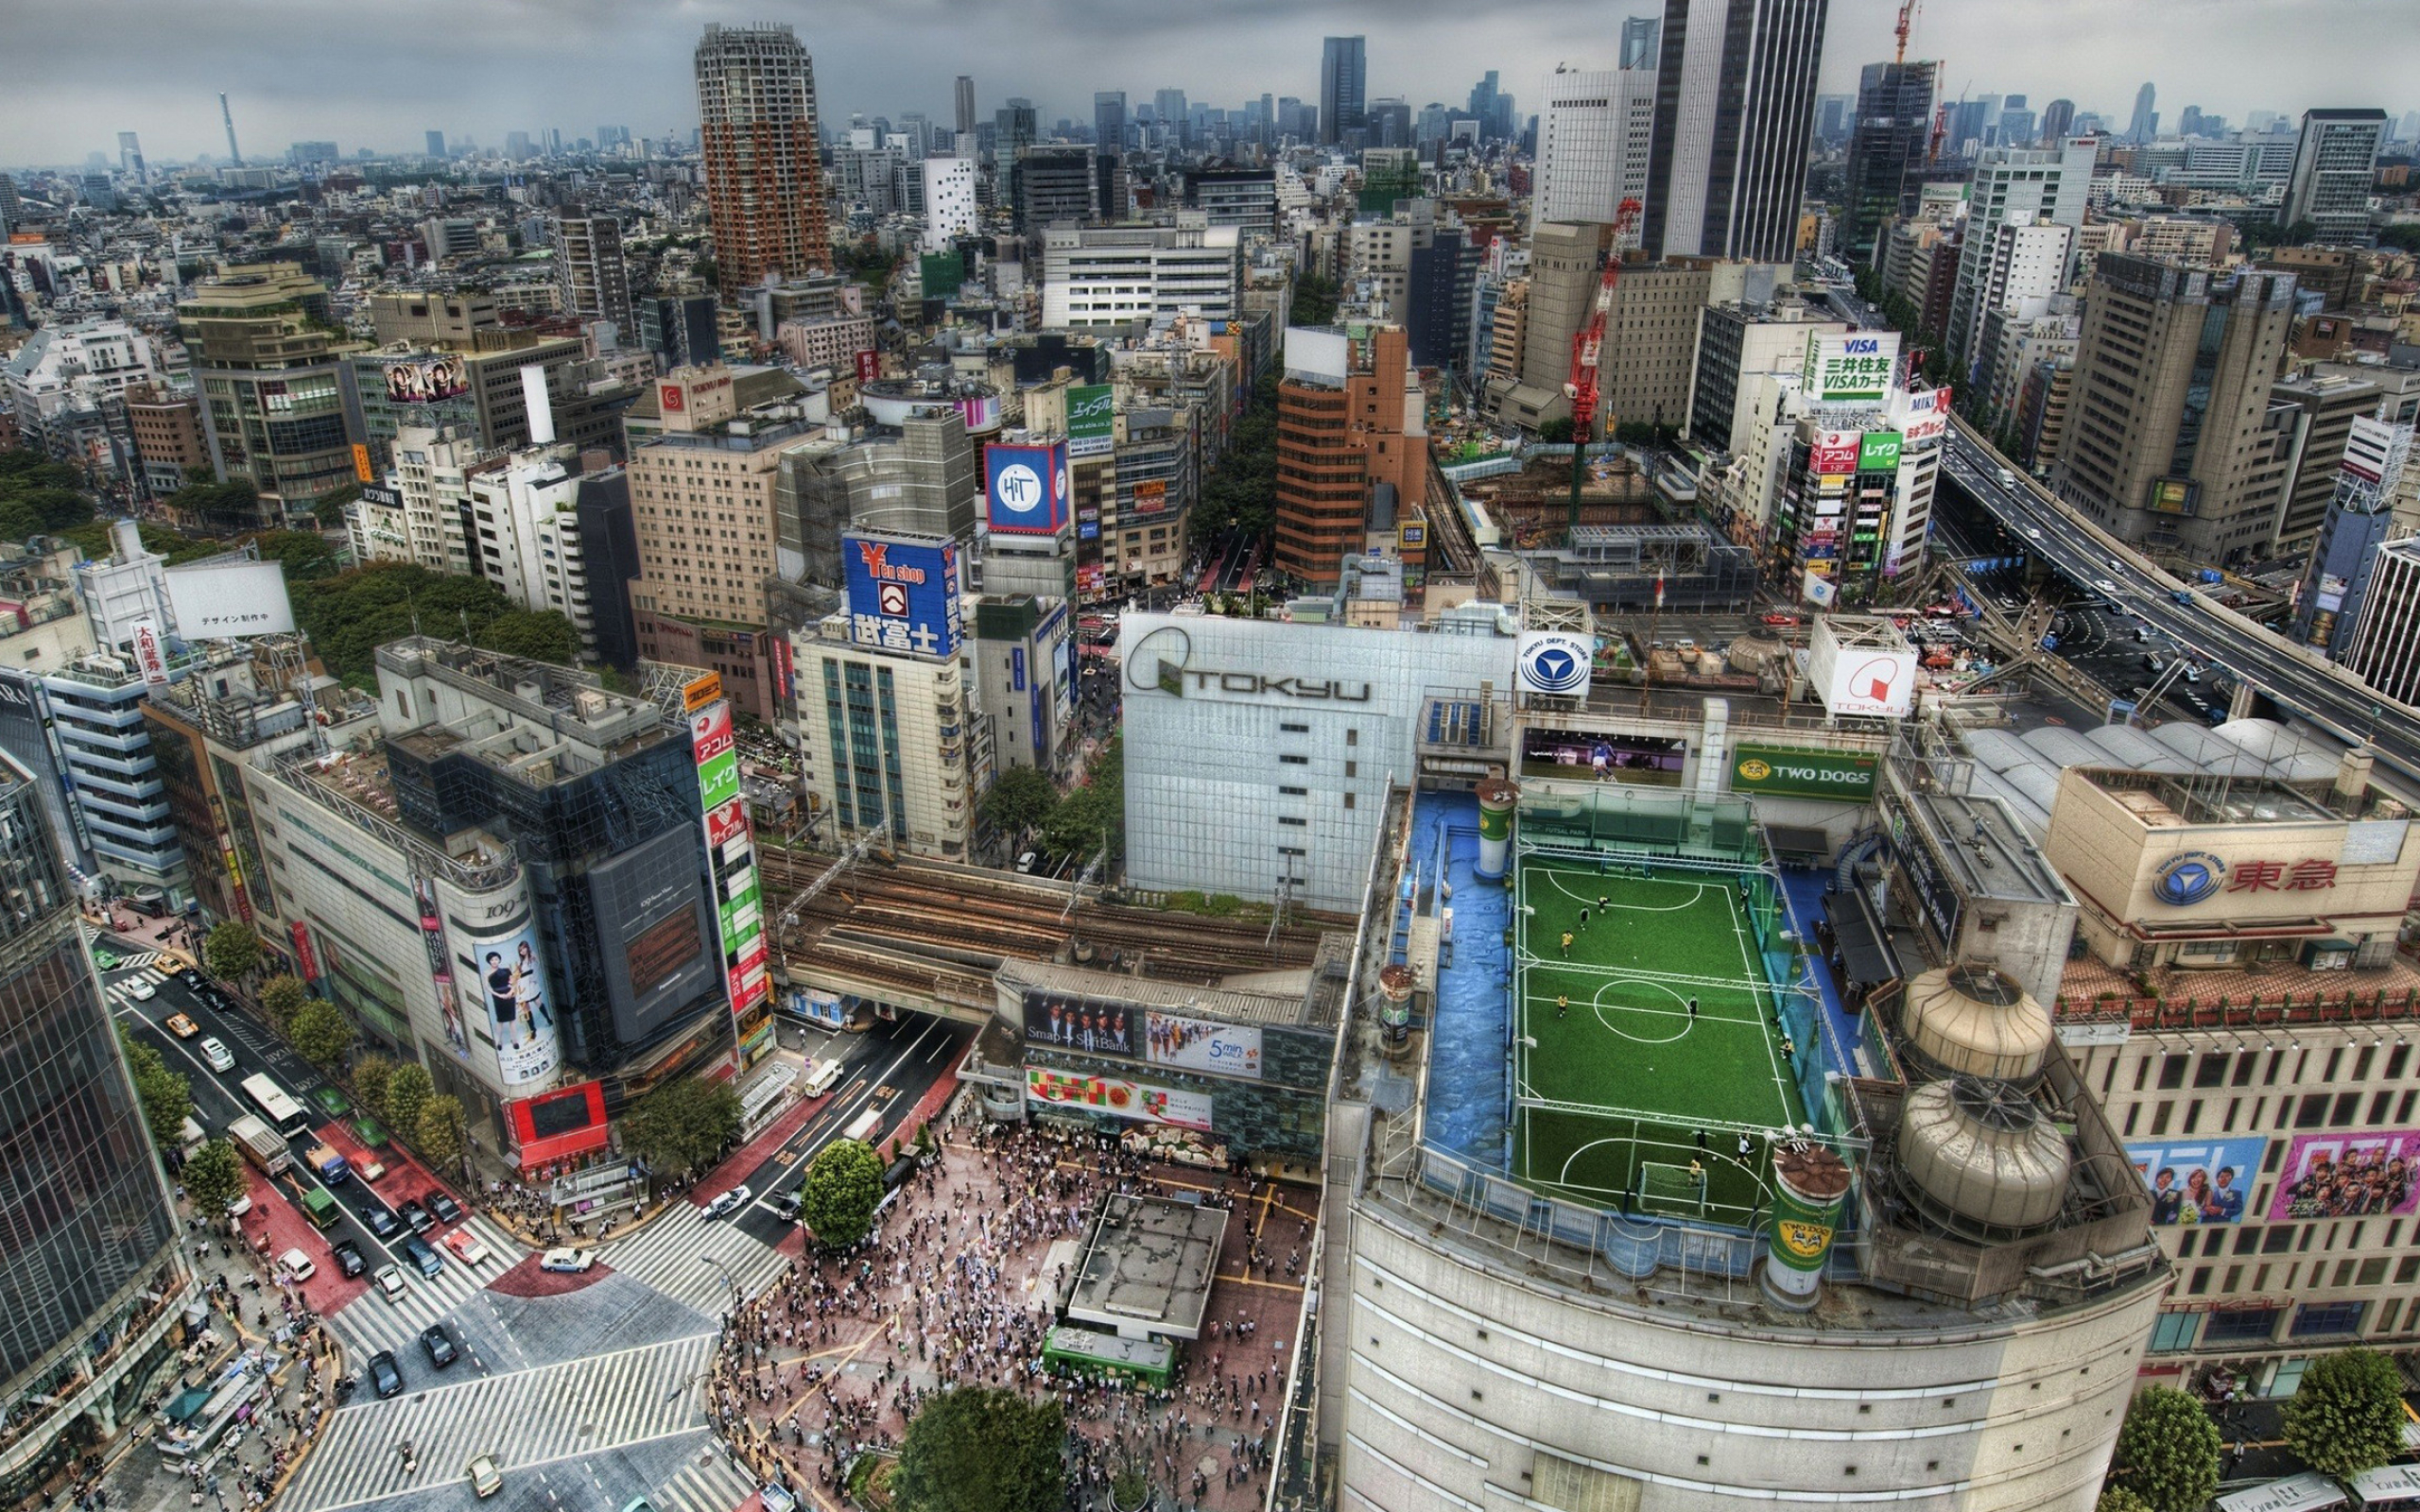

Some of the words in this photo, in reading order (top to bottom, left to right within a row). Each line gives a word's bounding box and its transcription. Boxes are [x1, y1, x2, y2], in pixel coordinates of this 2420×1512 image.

[1844, 339, 1877, 353] VISA
[1824, 357, 1891, 373] 三井住友
[692, 378, 716, 395] TOKYU
[1824, 375, 1889, 389] VISAカード
[1069, 394, 1113, 418] エイブル
[1910, 395, 1936, 411] MIKI
[1907, 421, 1945, 438] ミキプルーン
[1824, 450, 1854, 461] アコム
[1865, 443, 1897, 455] レイク
[897, 564, 925, 584] shop
[201, 613, 269, 626] デザイン制作中
[854, 613, 939, 654] 武富士
[136, 627, 162, 673] 大和証券
[1521, 640, 1544, 659] TOKYU
[1546, 637, 1566, 645] DEPT.
[1569, 642, 1589, 662] STORE
[689, 680, 720, 704] プロミス
[1184, 669, 1370, 702] TOKYU
[1833, 702, 1905, 714] TOKYU
[700, 734, 733, 759] アコム
[703, 765, 735, 795] レイク
[1772, 765, 1816, 782] TWO
[1819, 768, 1871, 784] DOGS
[712, 820, 744, 845] アイフル
[1545, 827, 1568, 835] FUTSAL
[1569, 828, 1587, 836] PARK
[2155, 853, 2183, 875] TOKYU
[1910, 860, 1930, 907] FUTSAL
[2226, 858, 2340, 893] 東急
[1028, 1025, 1061, 1044] Smap
[1209, 1040, 1223, 1057] 5
[1783, 1222, 1806, 1231] TWO
